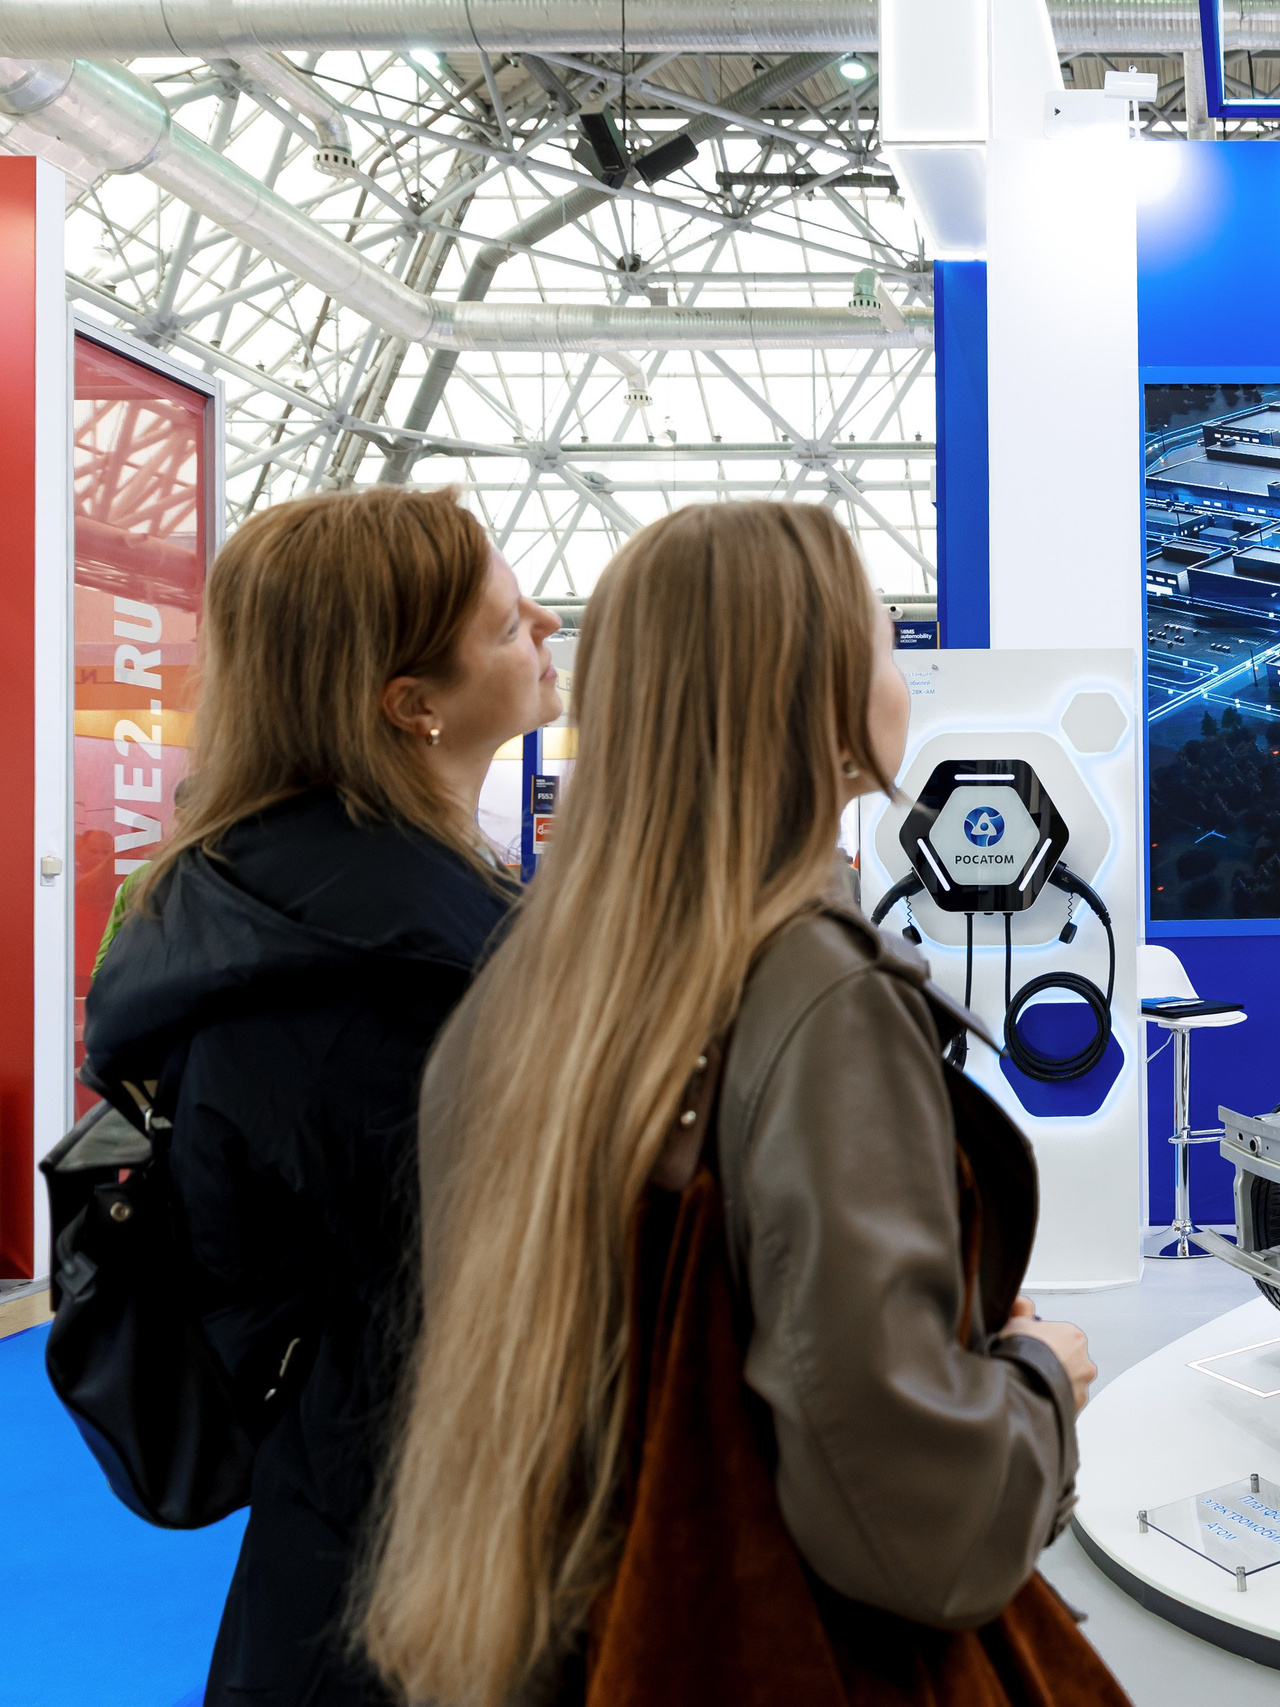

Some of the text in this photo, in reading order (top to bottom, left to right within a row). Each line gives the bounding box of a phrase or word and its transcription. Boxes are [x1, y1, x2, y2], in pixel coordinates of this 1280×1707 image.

[114, 595, 162, 899] IVE2.RU
[955, 855, 1014, 864] РОСАТОМ
[1203, 1522, 1237, 1541] Атом
